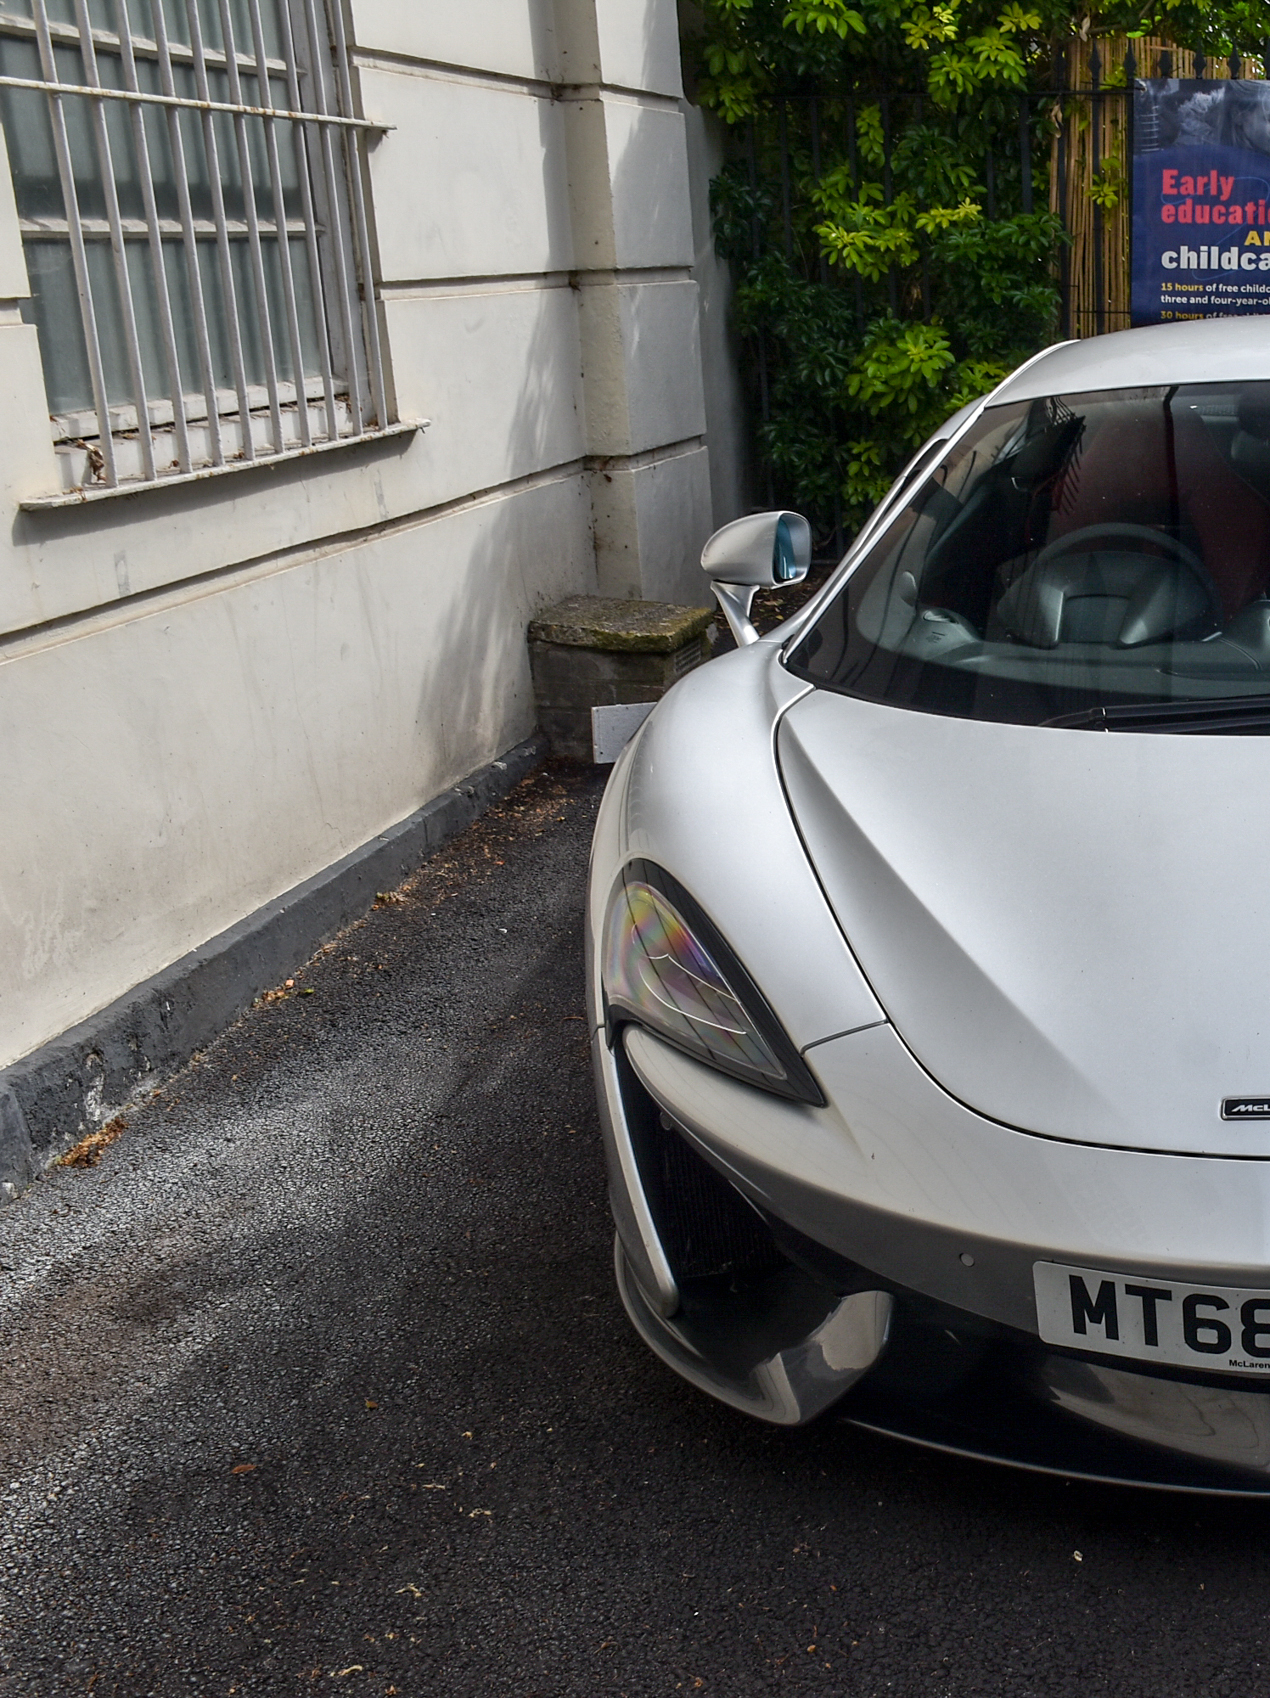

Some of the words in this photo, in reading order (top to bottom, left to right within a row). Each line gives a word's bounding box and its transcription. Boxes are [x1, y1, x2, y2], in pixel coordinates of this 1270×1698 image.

[1162, 169, 1234, 200] Early
[1160, 282, 1172, 291] 15
[1175, 282, 1204, 292] hours
[1206, 284, 1217, 292] of
[1218, 284, 1238, 292] free
[1160, 295, 1187, 304] three
[1190, 295, 1208, 304] and
[1160, 310, 1173, 319] 30
[1175, 311, 1204, 320] hours
[1229, 1360, 1270, 1369] McLaren
